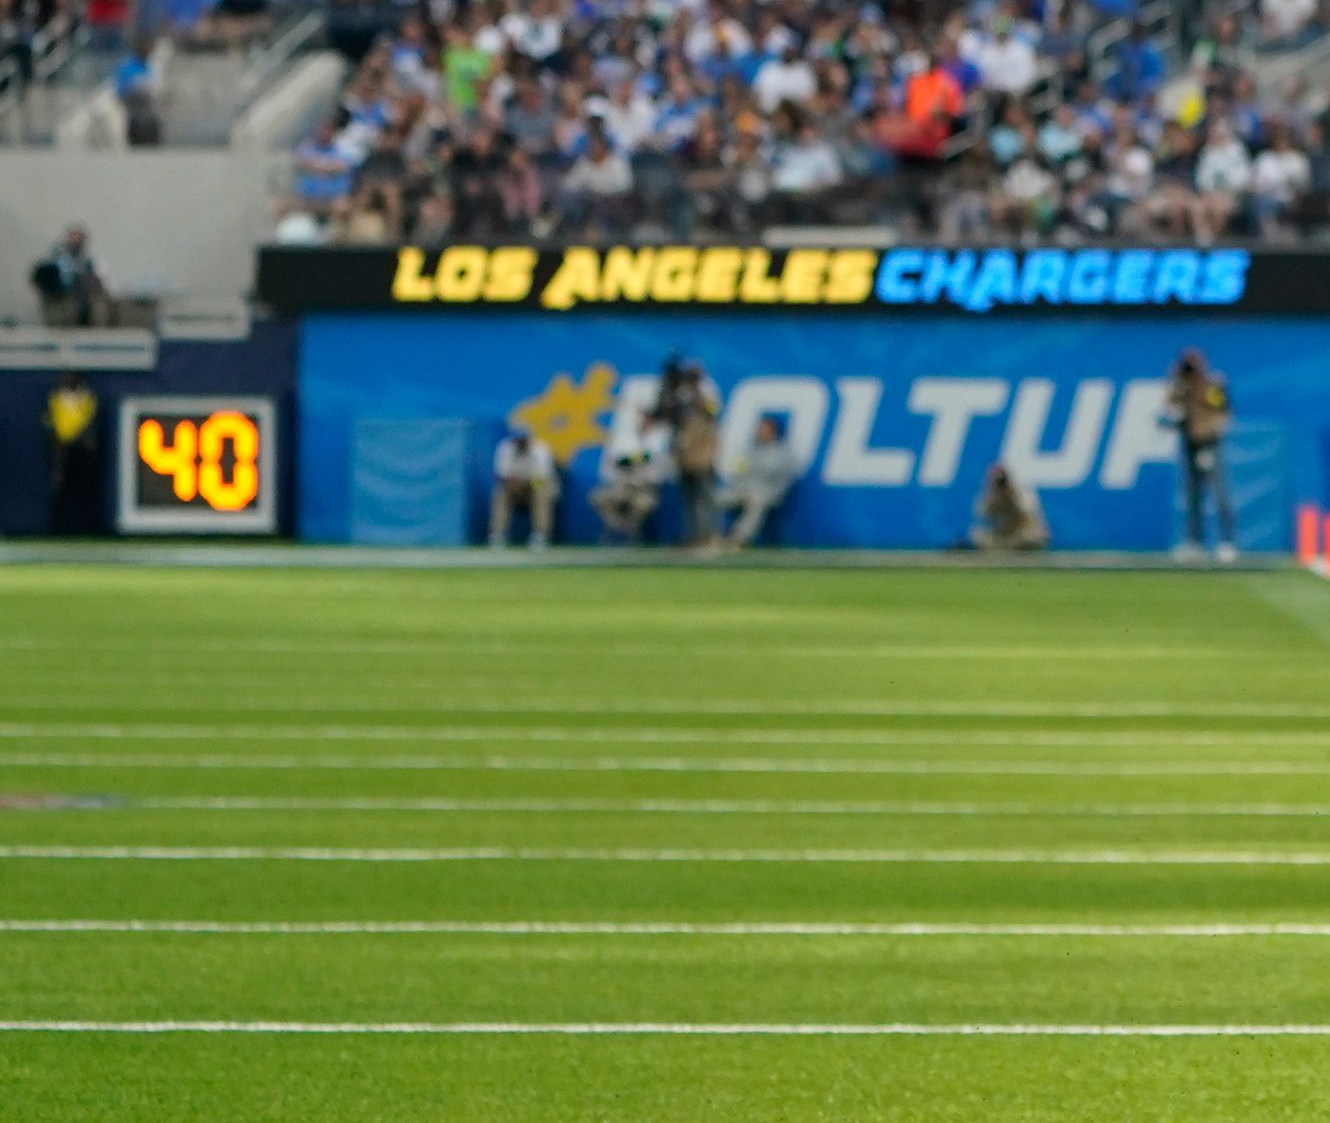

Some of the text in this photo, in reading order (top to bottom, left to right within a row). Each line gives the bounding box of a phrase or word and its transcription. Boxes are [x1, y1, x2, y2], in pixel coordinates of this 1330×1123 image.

[392, 246, 1251, 313] LOS ANGELES CHARGERS
[138, 411, 259, 511] 40
